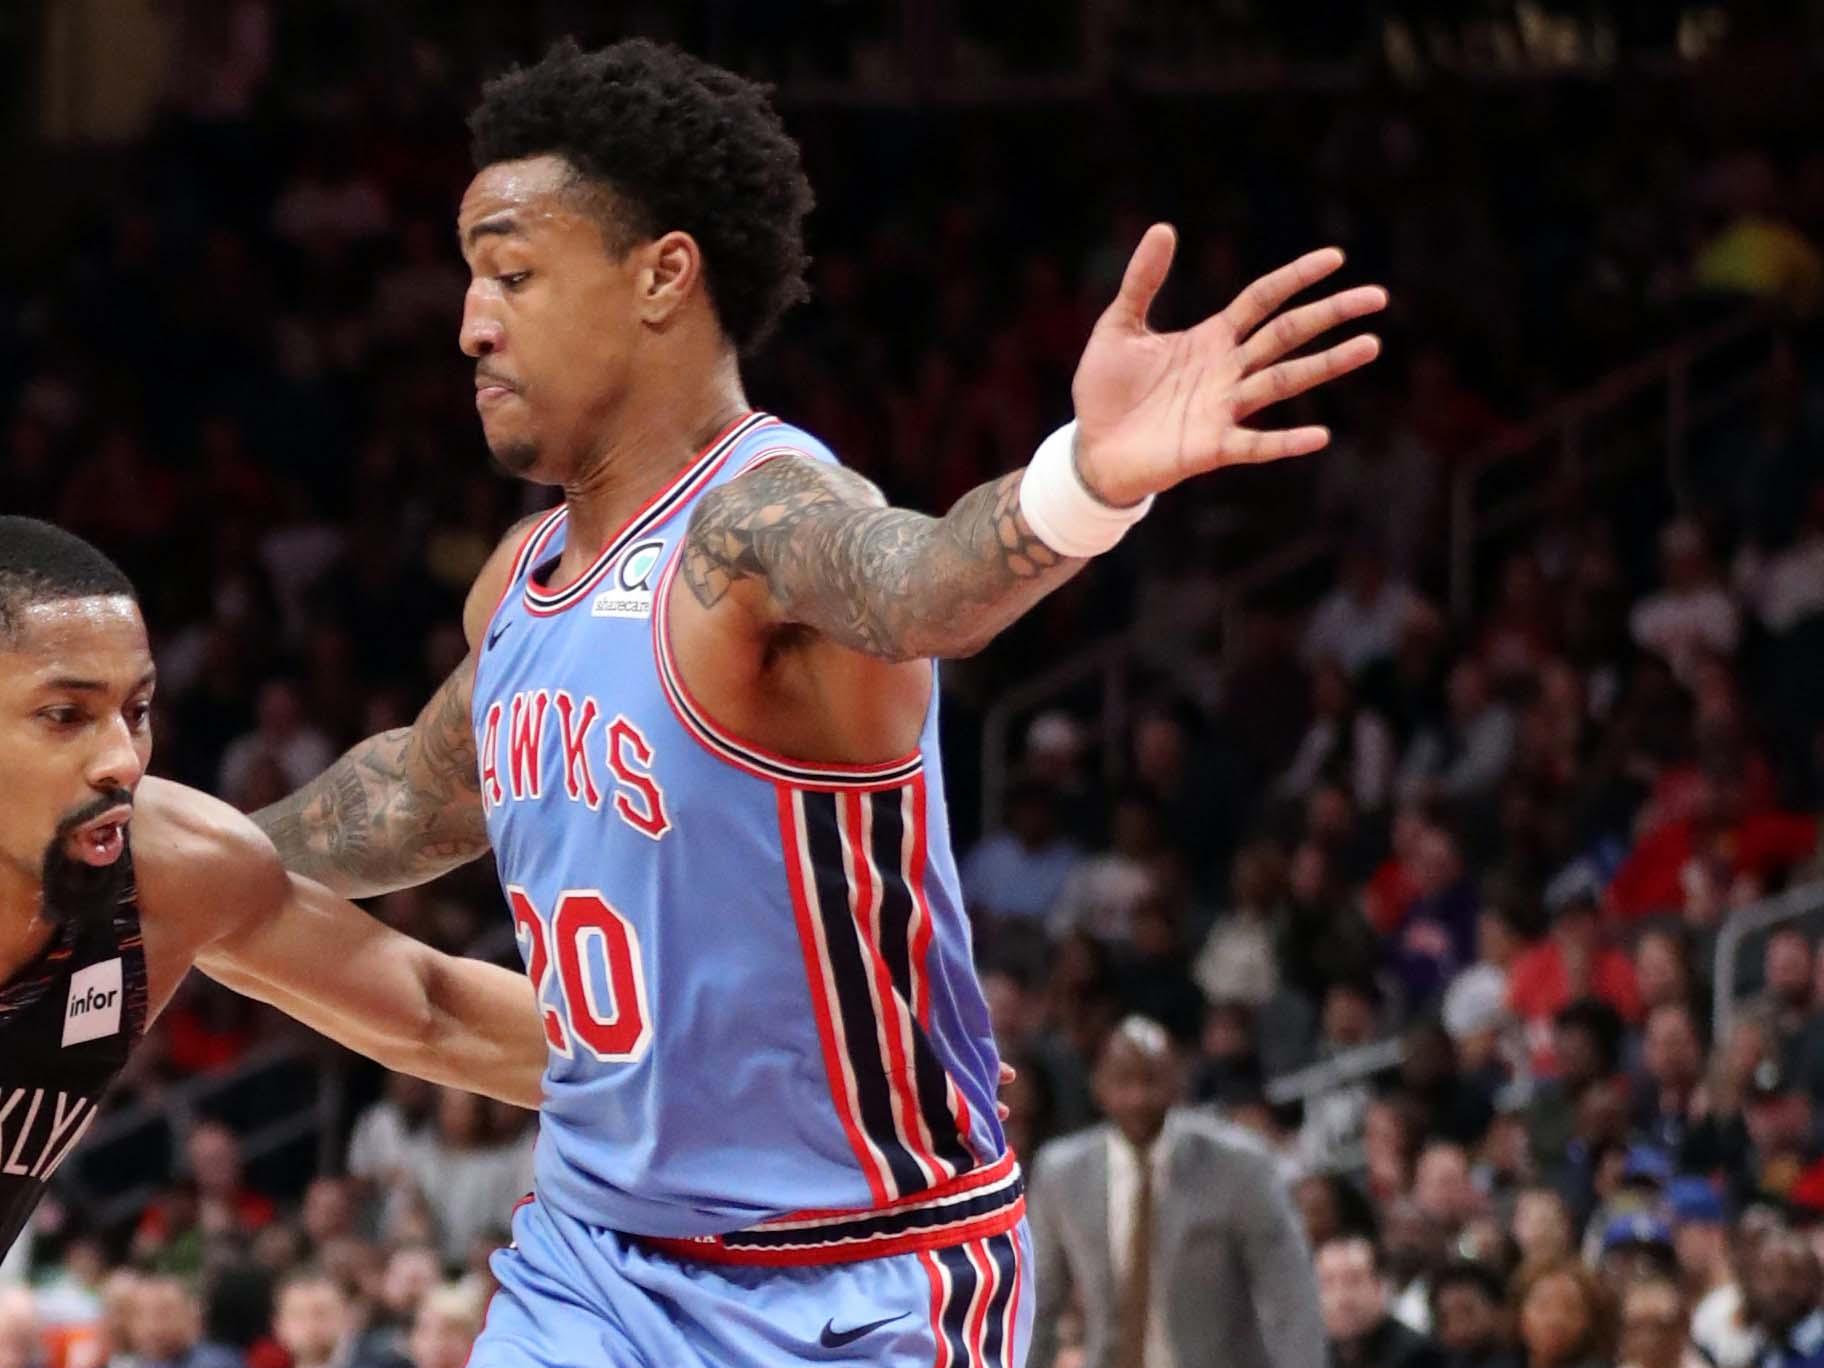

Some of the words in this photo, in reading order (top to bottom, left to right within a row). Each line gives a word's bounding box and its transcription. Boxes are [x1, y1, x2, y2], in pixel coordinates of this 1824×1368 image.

[481, 688, 672, 841] AWKS
[69, 986, 118, 1018] infor
[506, 884, 654, 1064] 20
